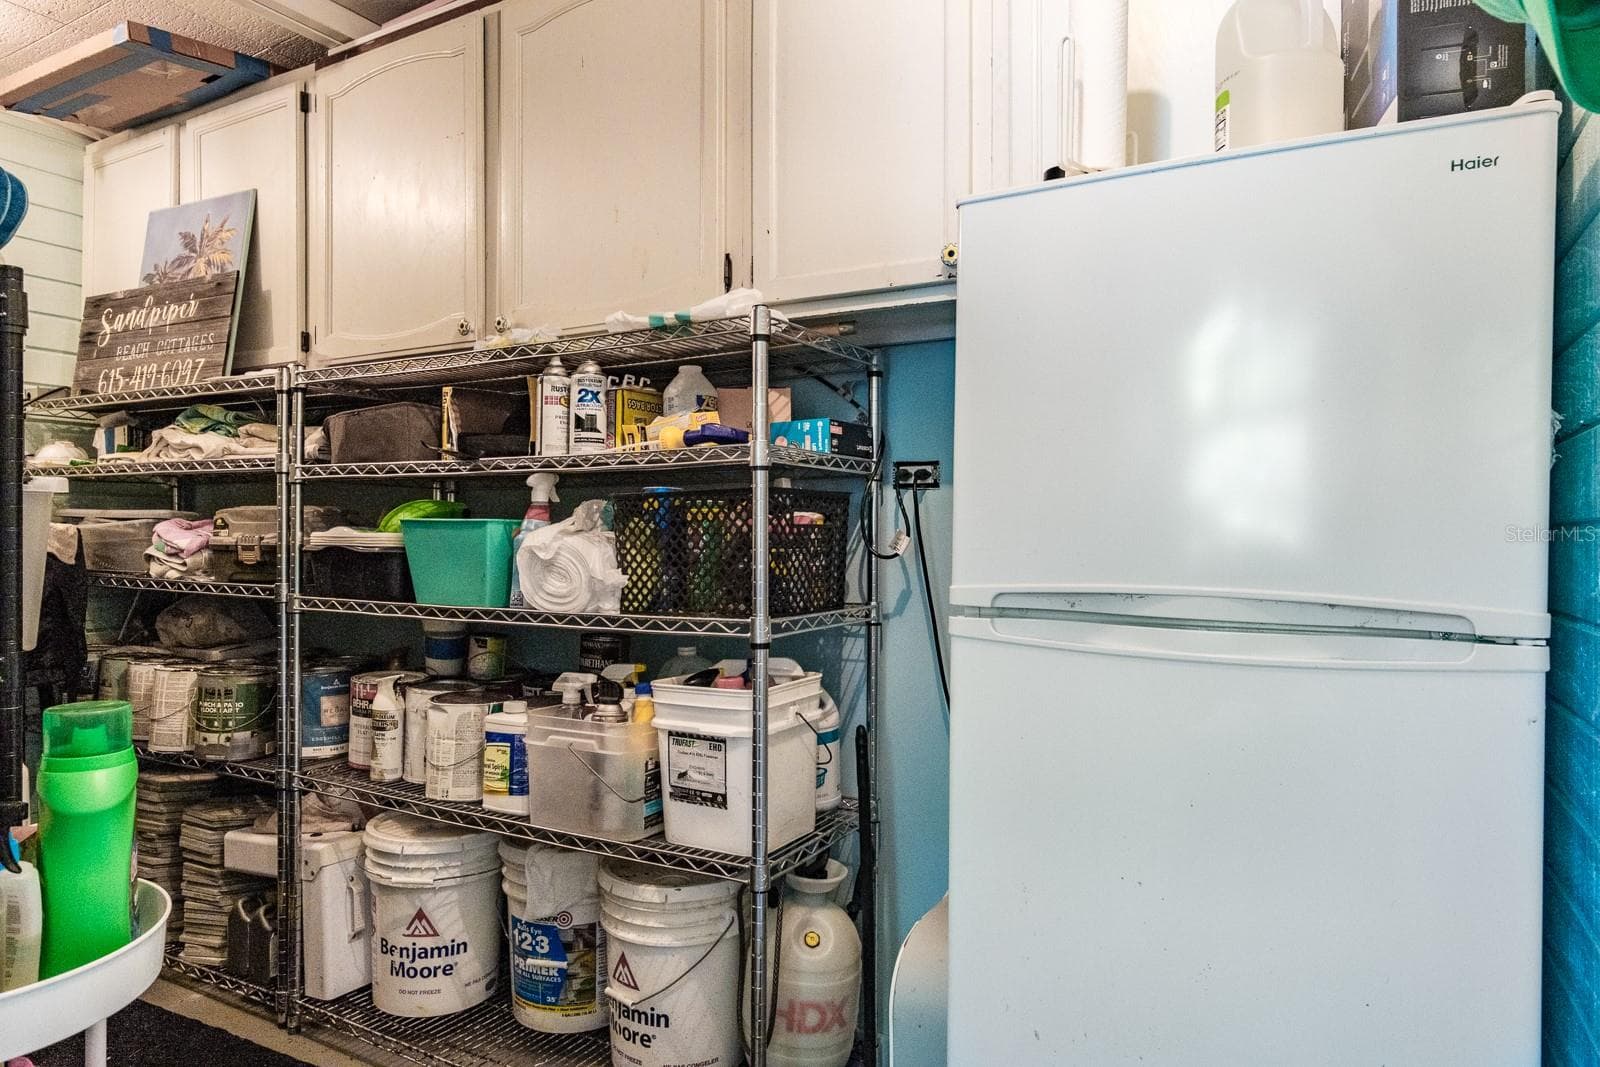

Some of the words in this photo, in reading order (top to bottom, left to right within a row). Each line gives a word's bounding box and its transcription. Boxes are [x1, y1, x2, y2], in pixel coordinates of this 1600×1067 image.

[1451, 156, 1499, 171] Haier
[98, 292, 199, 347] Sandpiper
[116, 341, 150, 361] BEACH
[156, 332, 215, 357] COTTAGES
[98, 357, 205, 395] 615-419-6097
[578, 388, 602, 404] 2X
[353, 698, 369, 710] BEHR
[380, 937, 468, 963] Benjamin
[390, 960, 455, 979] Moore
[531, 974, 562, 983] SURFACES
[419, 988, 442, 996] FREEZE
